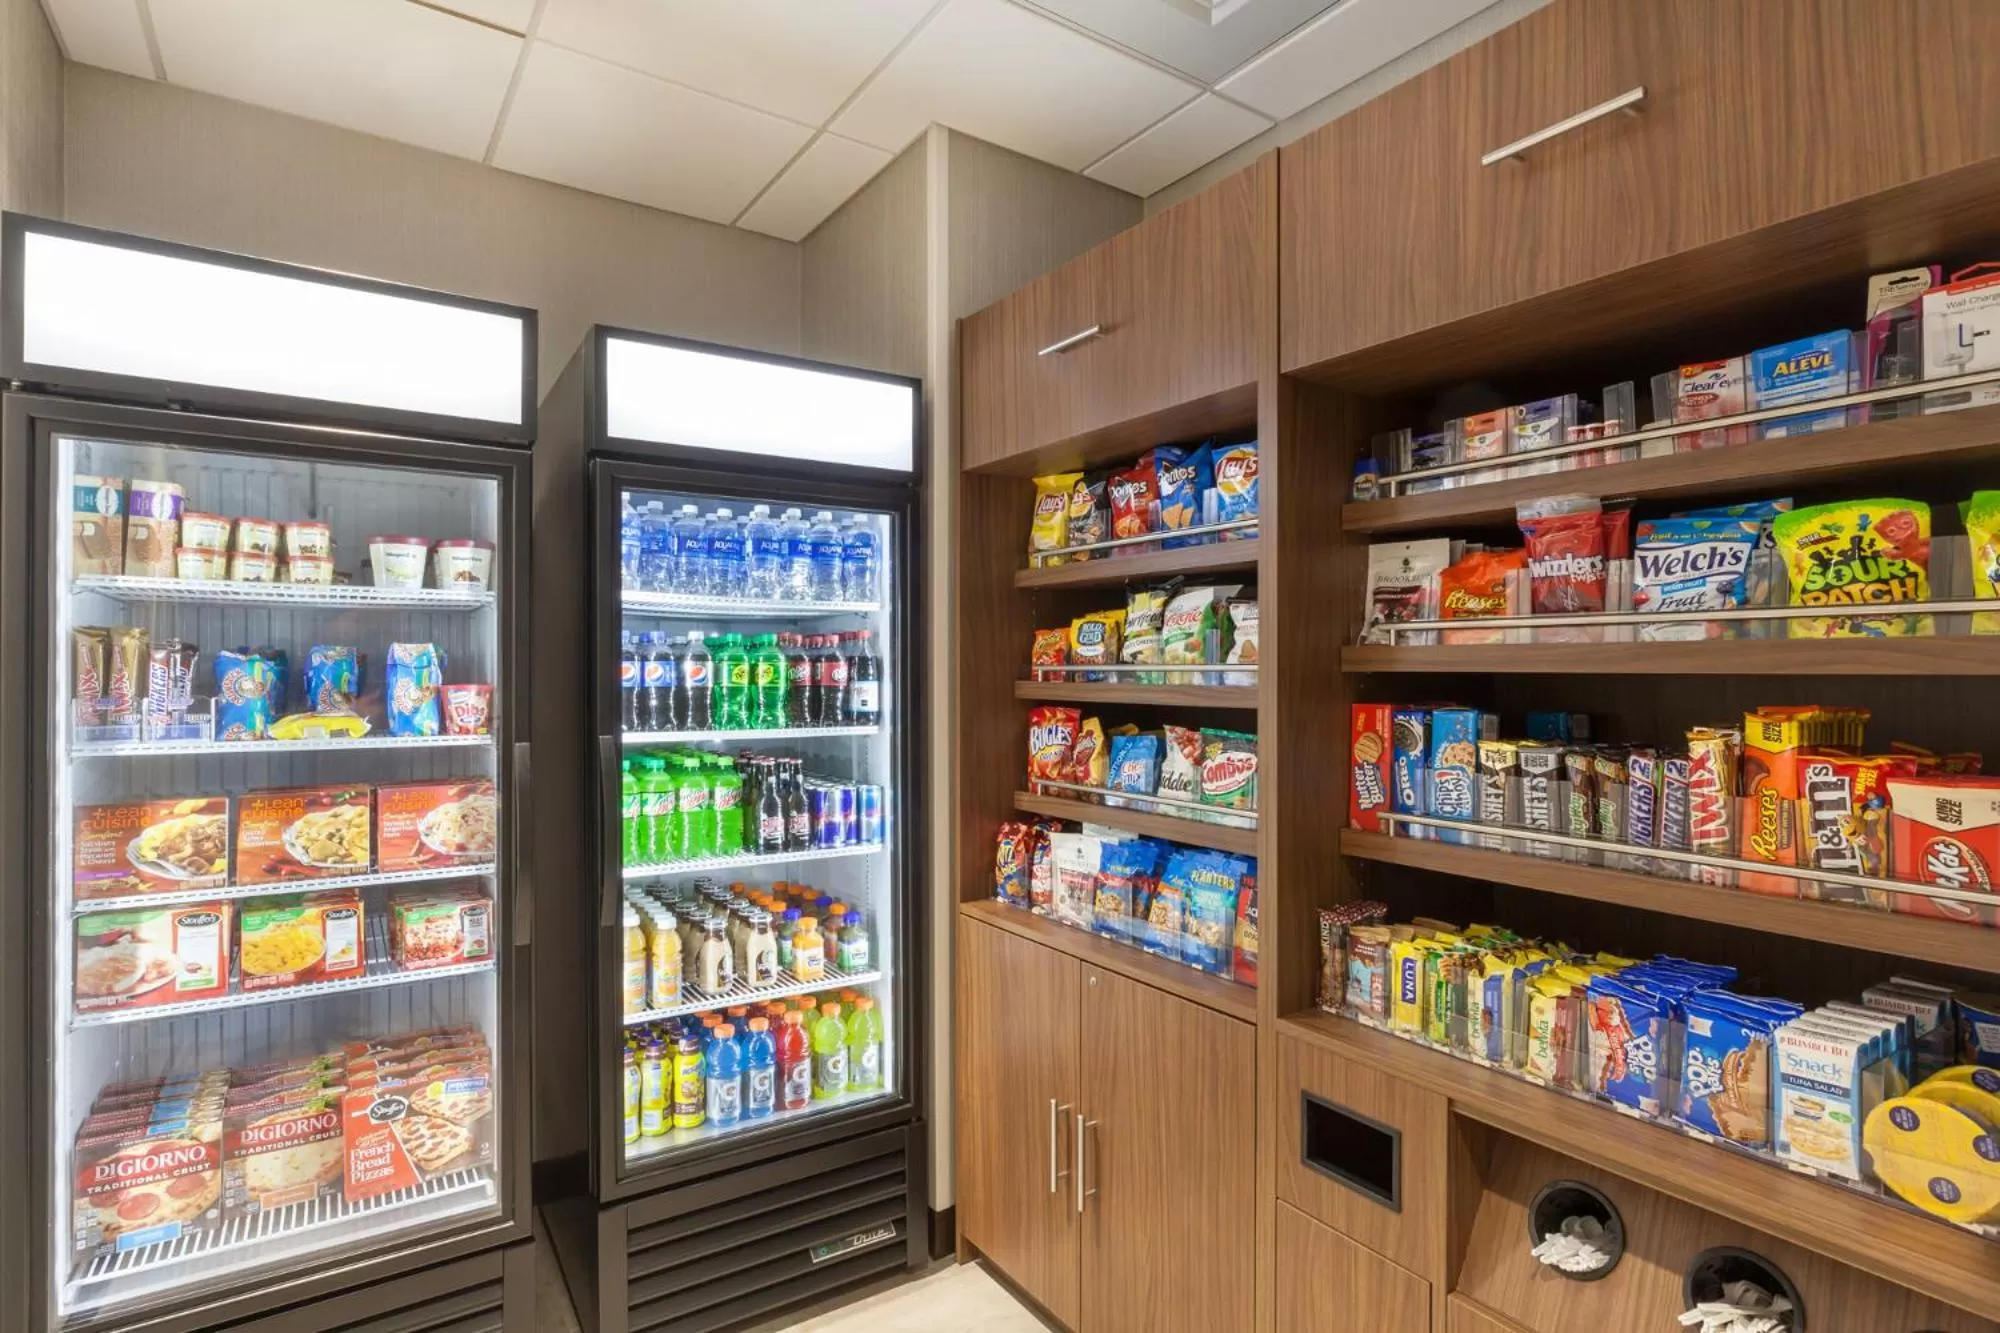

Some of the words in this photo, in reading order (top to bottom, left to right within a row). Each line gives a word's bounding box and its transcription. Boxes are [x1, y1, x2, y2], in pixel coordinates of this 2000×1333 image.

[1946, 297, 1966, 309] Wall
[1683, 380, 1716, 393] Clear
[1637, 545, 1745, 579] Welch's
[1805, 557, 1908, 592] SOUR
[1656, 591, 1708, 612] Fruit
[1801, 577, 1920, 607] PATCH
[455, 703, 485, 718] Dibs
[1029, 724, 1073, 756] BUGLES
[1354, 765, 1373, 810] Nutter
[1363, 761, 1384, 804] Butter
[1400, 756, 1415, 806] OREO
[1688, 746, 1730, 843] TWIX
[1437, 779, 1457, 816] Chips
[1936, 797, 1950, 823] KING
[1751, 787, 1779, 861] Reese's
[1950, 800, 1963, 825] SIZE
[1190, 868, 1236, 891] PLANTERS
[1320, 922, 1331, 948] KIND
[1403, 962, 1416, 1001] LUNA
[1786, 1036, 1829, 1053] BUMBLE
[1830, 1045, 1849, 1058] BEE
[1786, 1051, 1843, 1079] Snack
[1788, 1076, 1812, 1088] TUNA
[1813, 1081, 1844, 1095] SALAD
[233, 1137, 305, 1158] TRADITIONAL
[308, 1127, 342, 1142] CRUST
[350, 1141, 396, 1161] French
[350, 1153, 391, 1173] Bread
[351, 1165, 395, 1185] Pizzas
[86, 1172, 169, 1195] TRADITIONAL
[172, 1162, 212, 1178] CRUST
